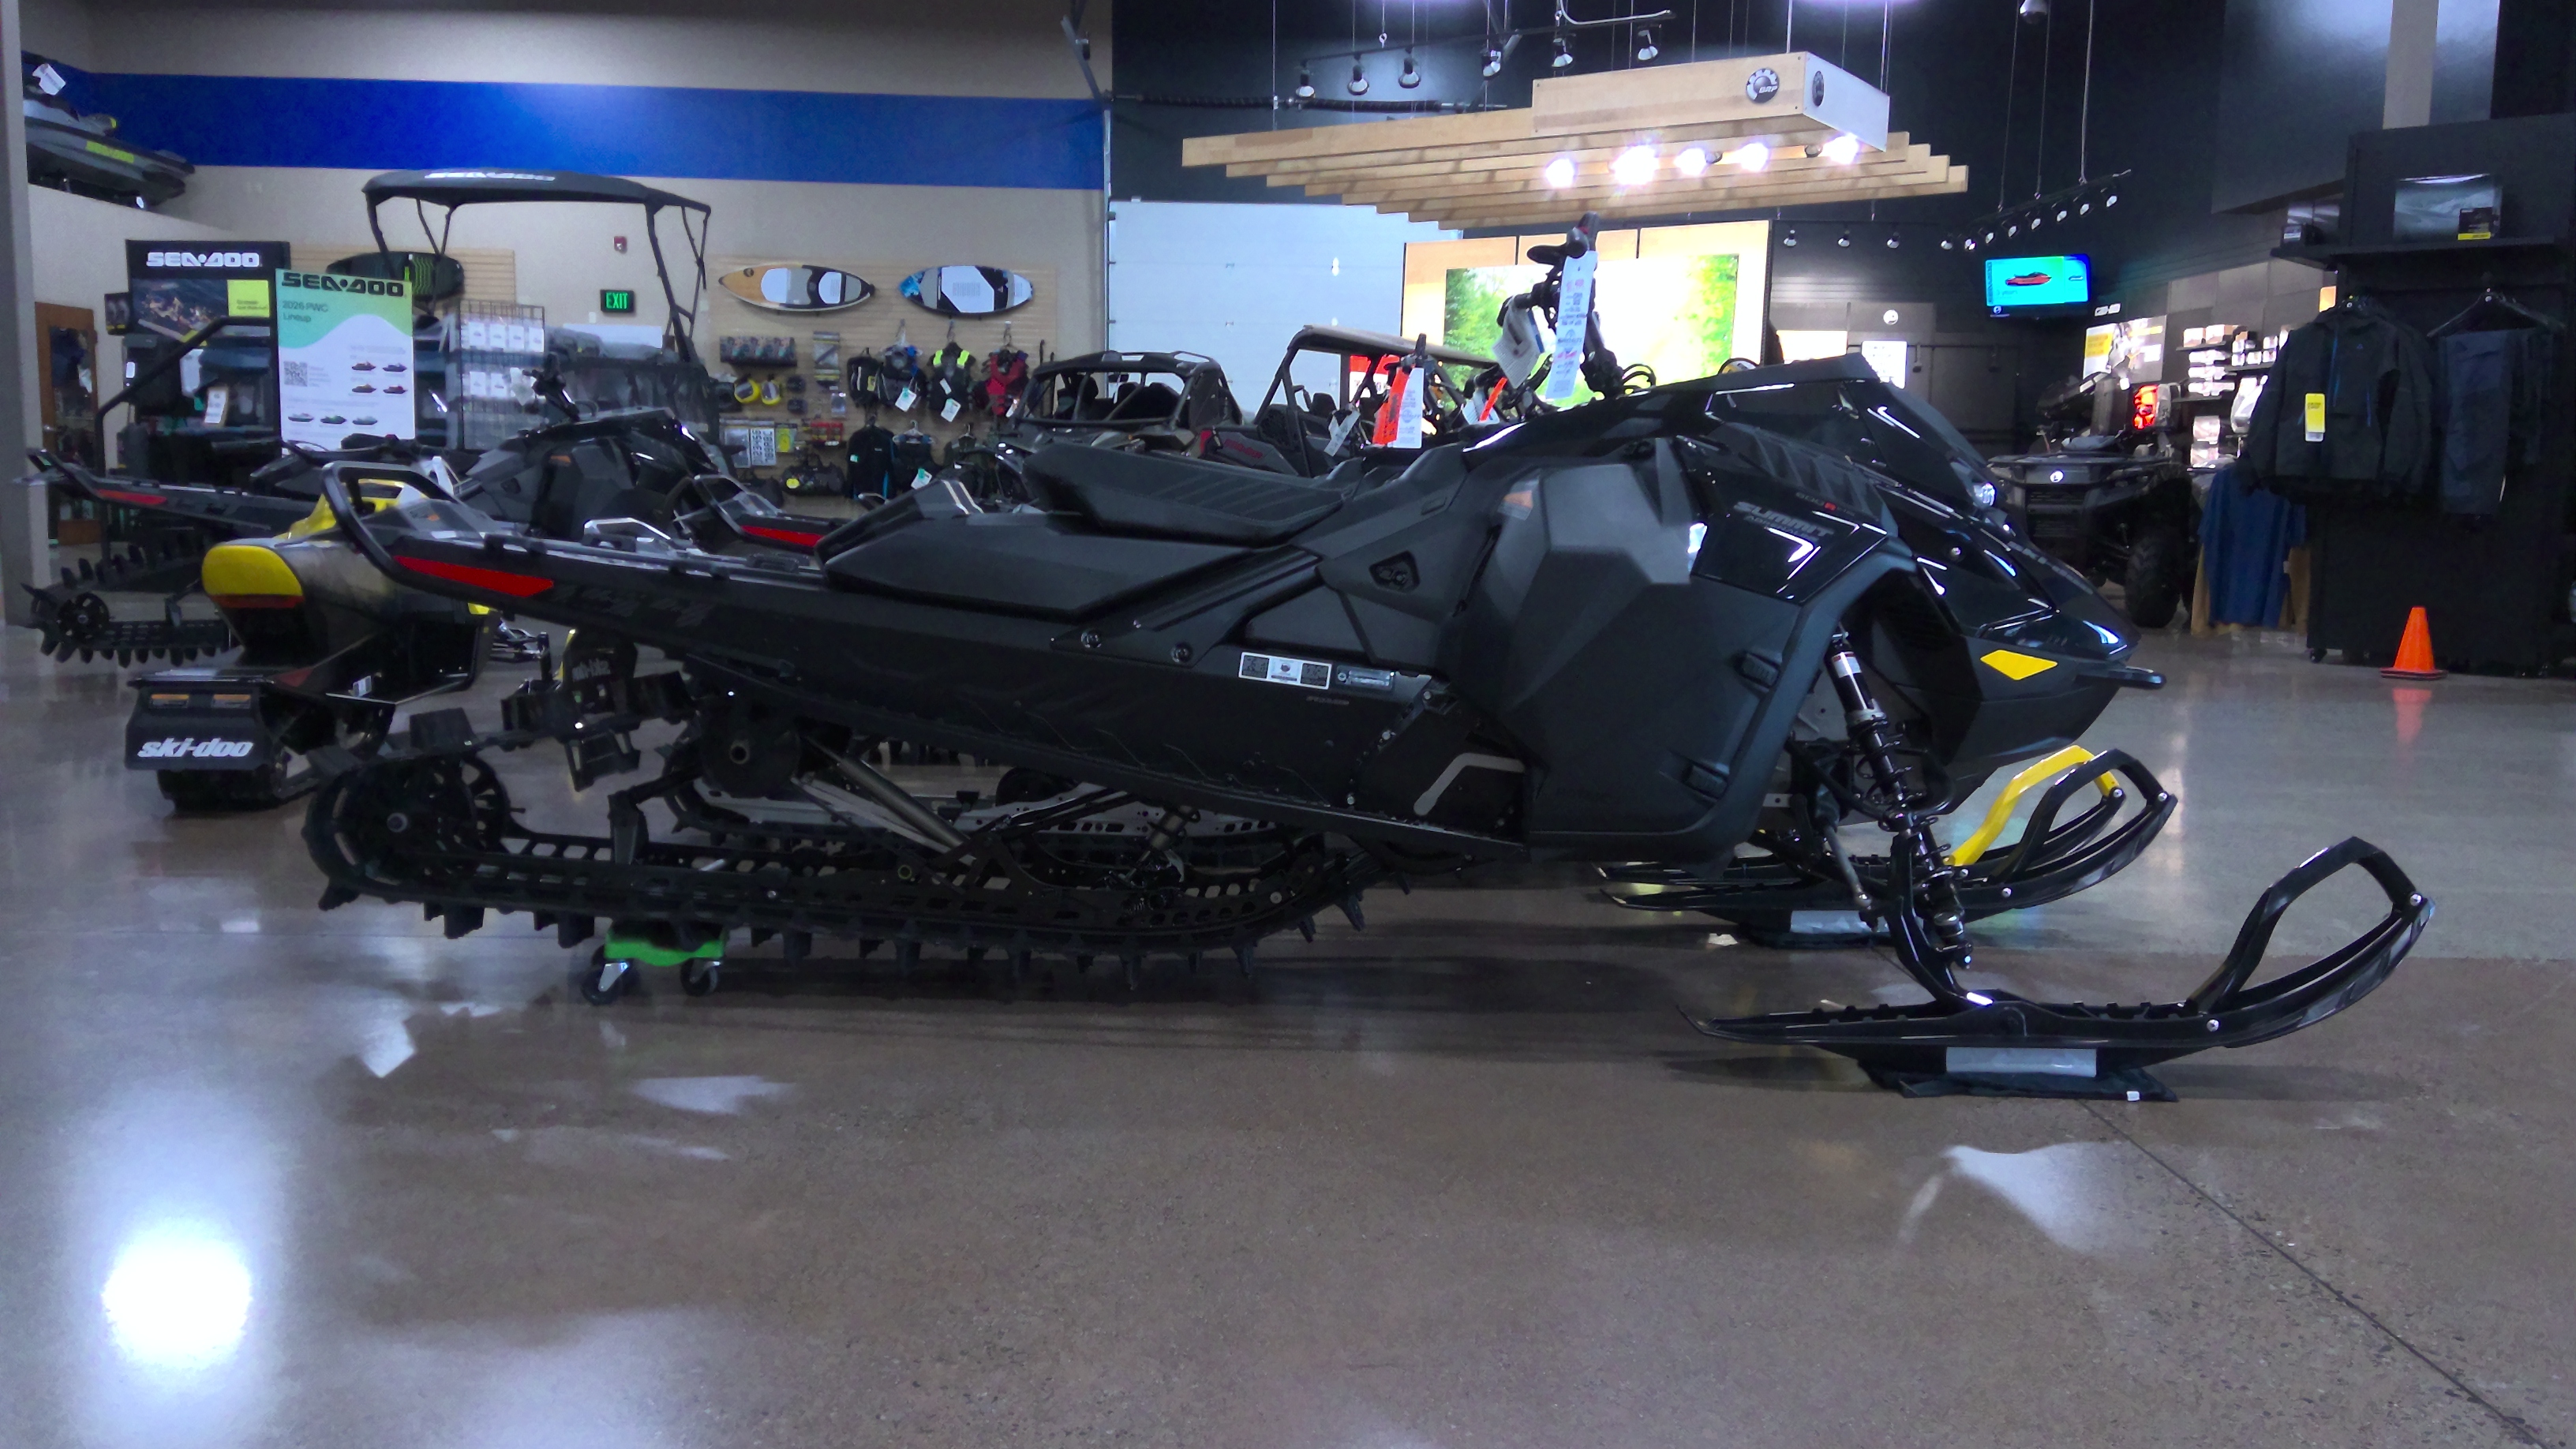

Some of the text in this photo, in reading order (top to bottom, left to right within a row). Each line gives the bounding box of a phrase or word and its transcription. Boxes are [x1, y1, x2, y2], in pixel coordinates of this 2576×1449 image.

[282, 300, 329, 313] 2026 PWC
[605, 292, 628, 309] EXIT
[283, 313, 312, 323] Lineup
[1733, 500, 1835, 537] SUMMIT
[137, 737, 254, 758] ski-doo
